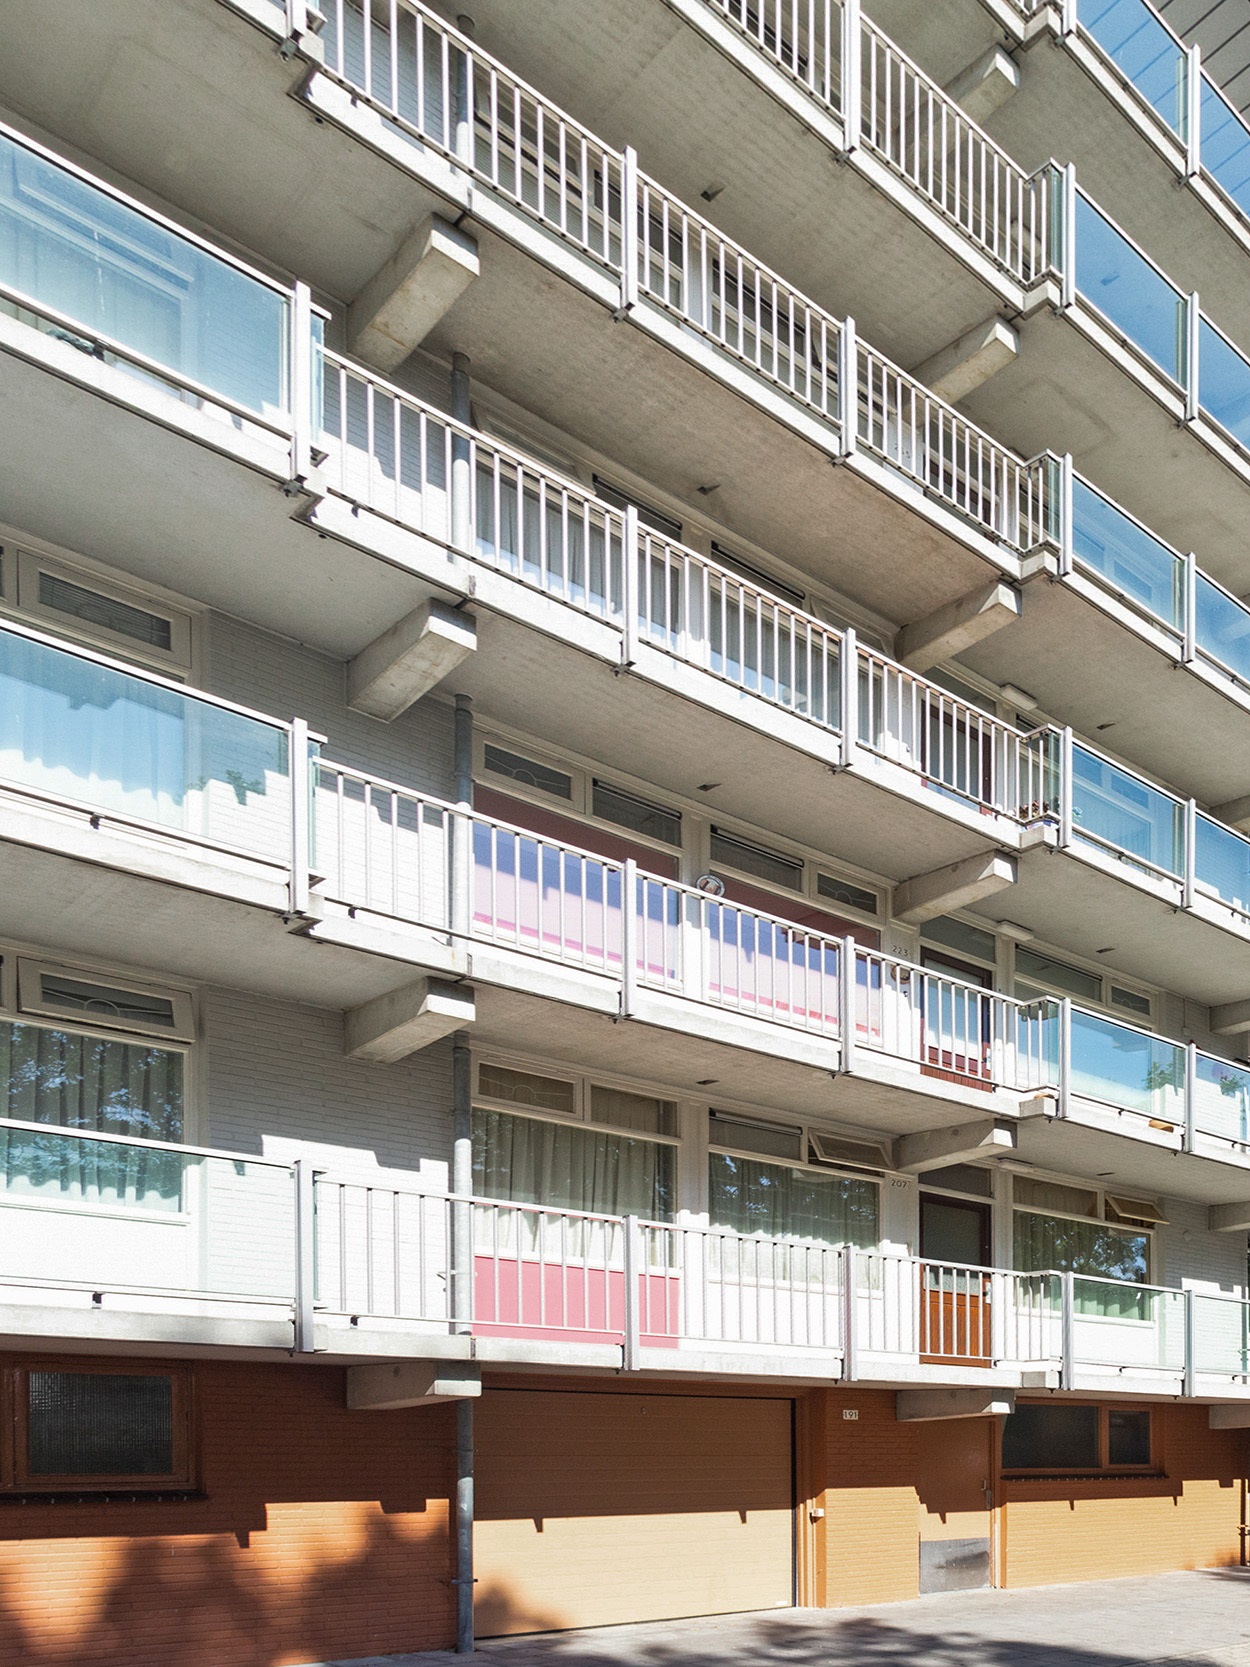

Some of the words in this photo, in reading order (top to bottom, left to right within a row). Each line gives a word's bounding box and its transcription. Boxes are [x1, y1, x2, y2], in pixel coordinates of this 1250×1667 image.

[892, 945, 908, 956] 223
[891, 1179, 907, 1189] 207
[844, 1410, 857, 1419] 191
